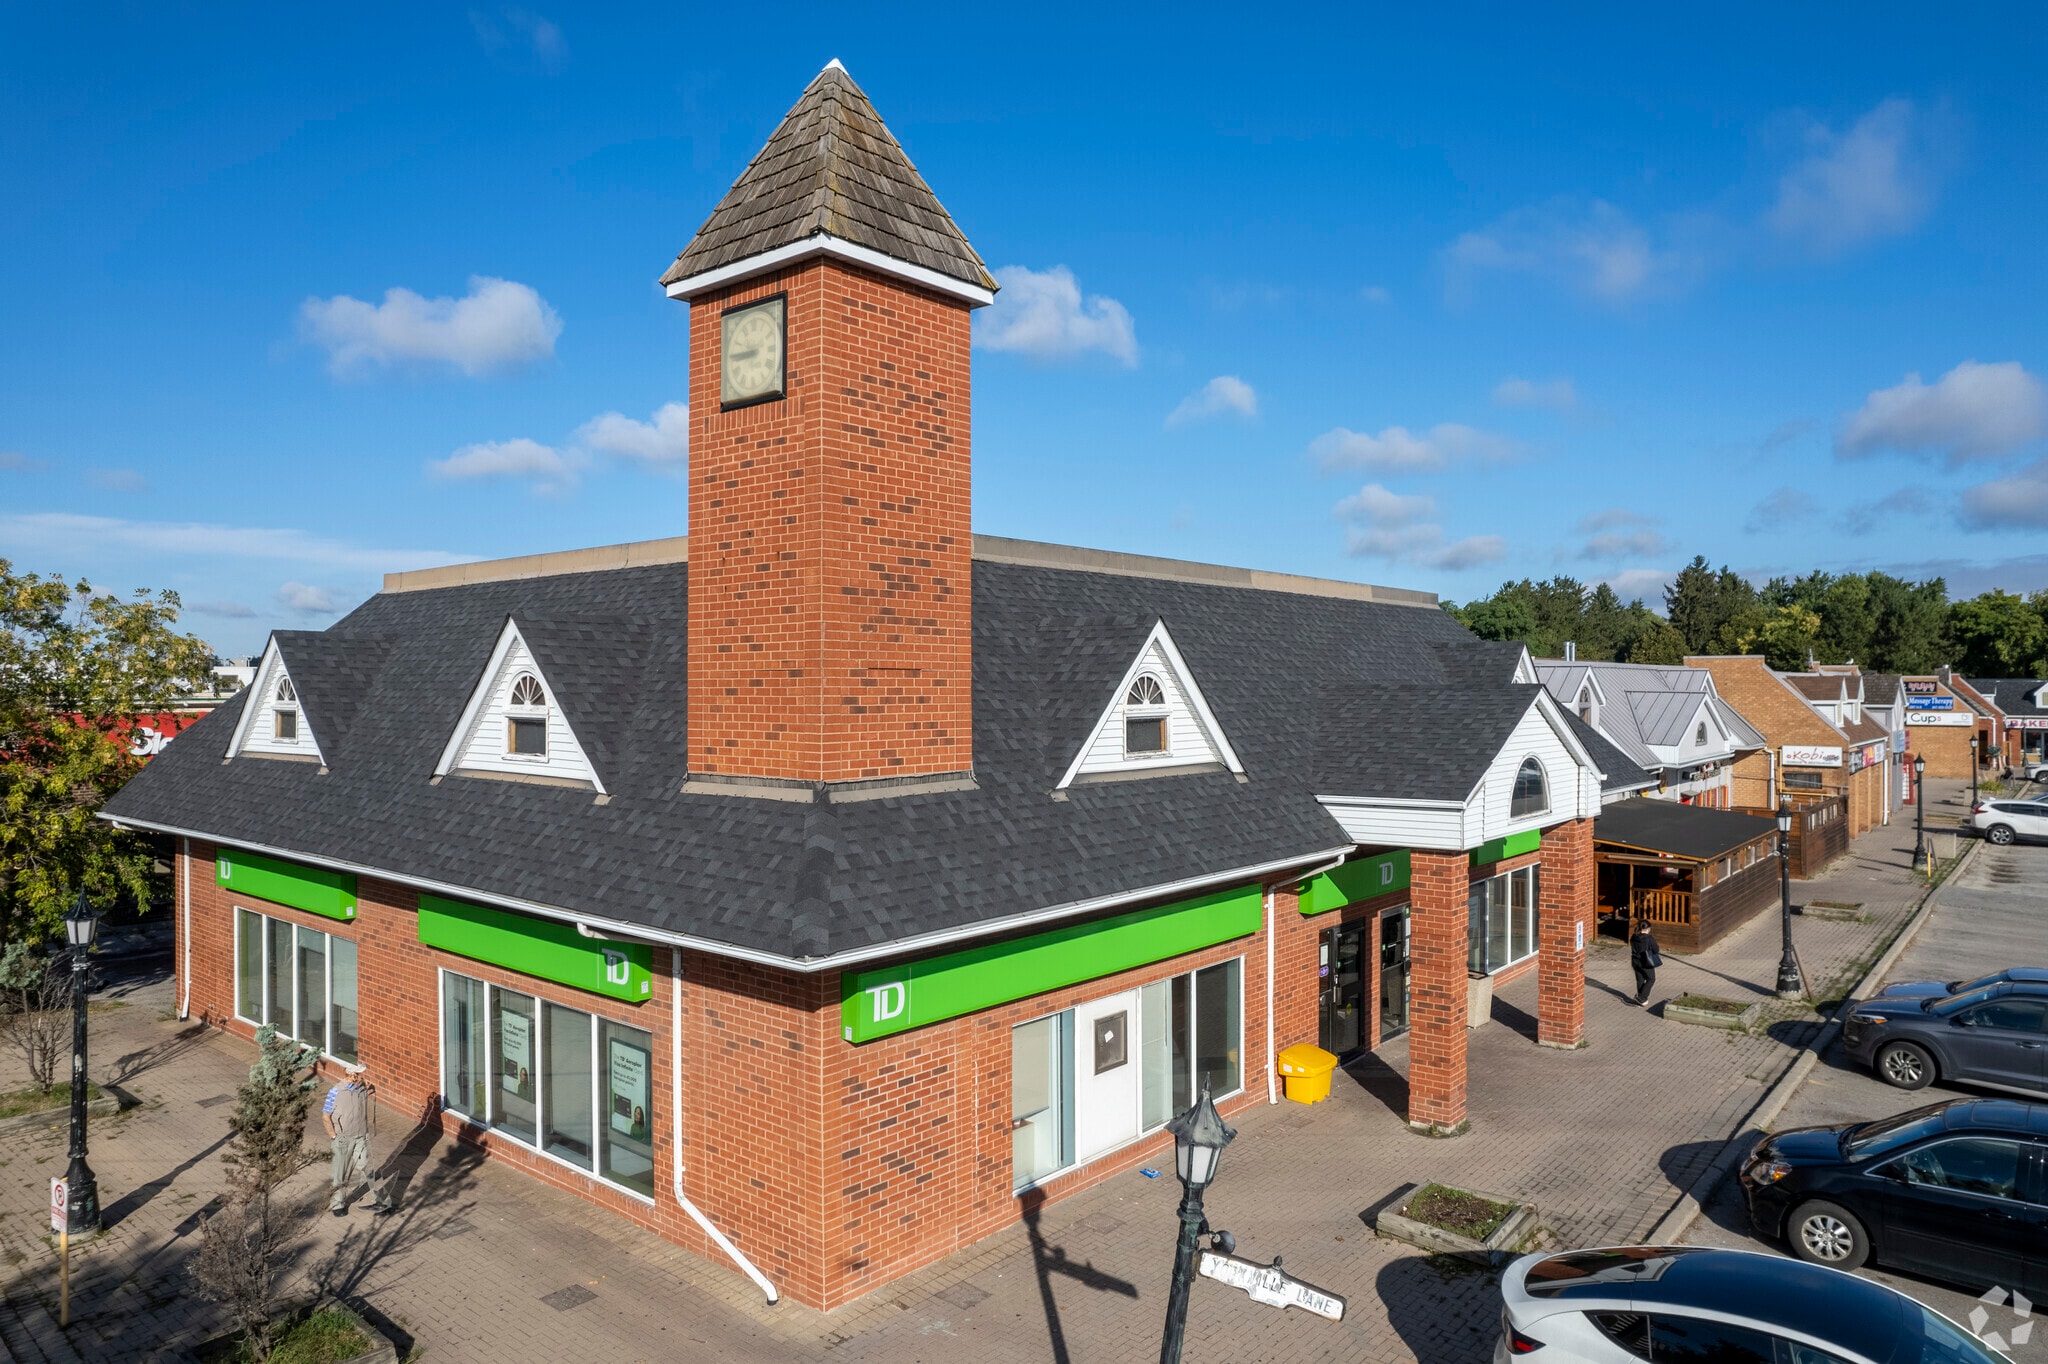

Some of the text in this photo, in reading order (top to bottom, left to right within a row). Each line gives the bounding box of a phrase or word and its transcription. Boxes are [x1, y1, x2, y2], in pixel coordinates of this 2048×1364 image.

[219, 856, 231, 879] TD
[1379, 861, 1394, 885] TD
[602, 948, 629, 985] TD
[865, 981, 905, 1023] TD
[1296, 1288, 1333, 1314] LANE
